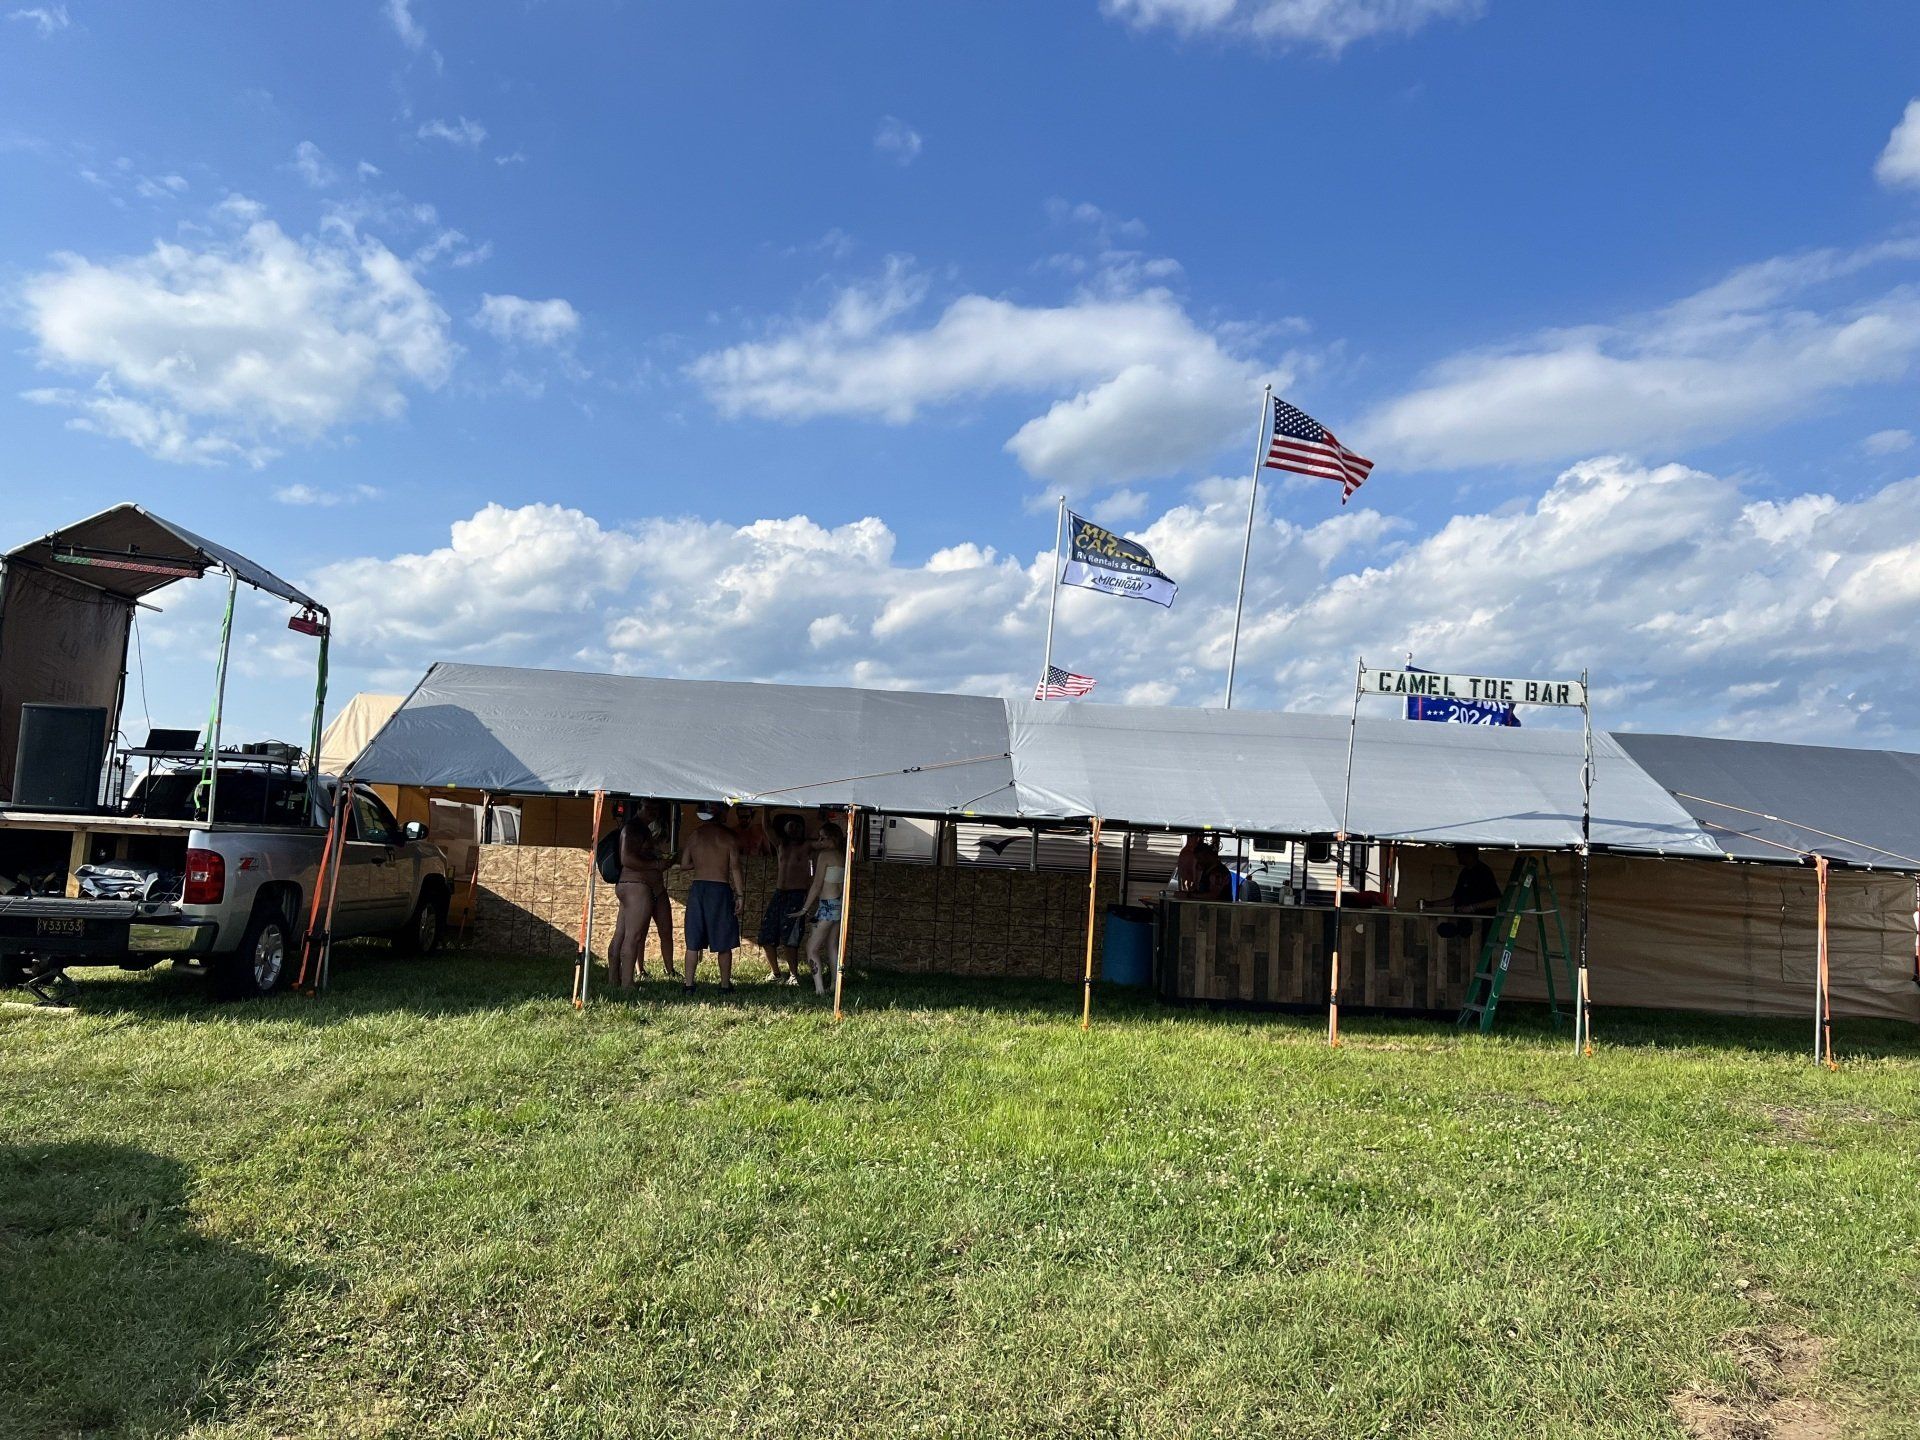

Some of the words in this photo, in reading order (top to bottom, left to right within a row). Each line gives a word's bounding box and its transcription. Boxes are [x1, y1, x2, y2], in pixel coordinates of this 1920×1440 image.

[1088, 555, 1118, 569] Rentals
[1121, 562, 1128, 570] &
[1098, 575, 1145, 592] MICHIGAN
[1379, 672, 1455, 696] CAMEL
[1469, 678, 1512, 699] TOE
[1525, 682, 1569, 703] BAR
[1447, 706, 1492, 726] 2024
